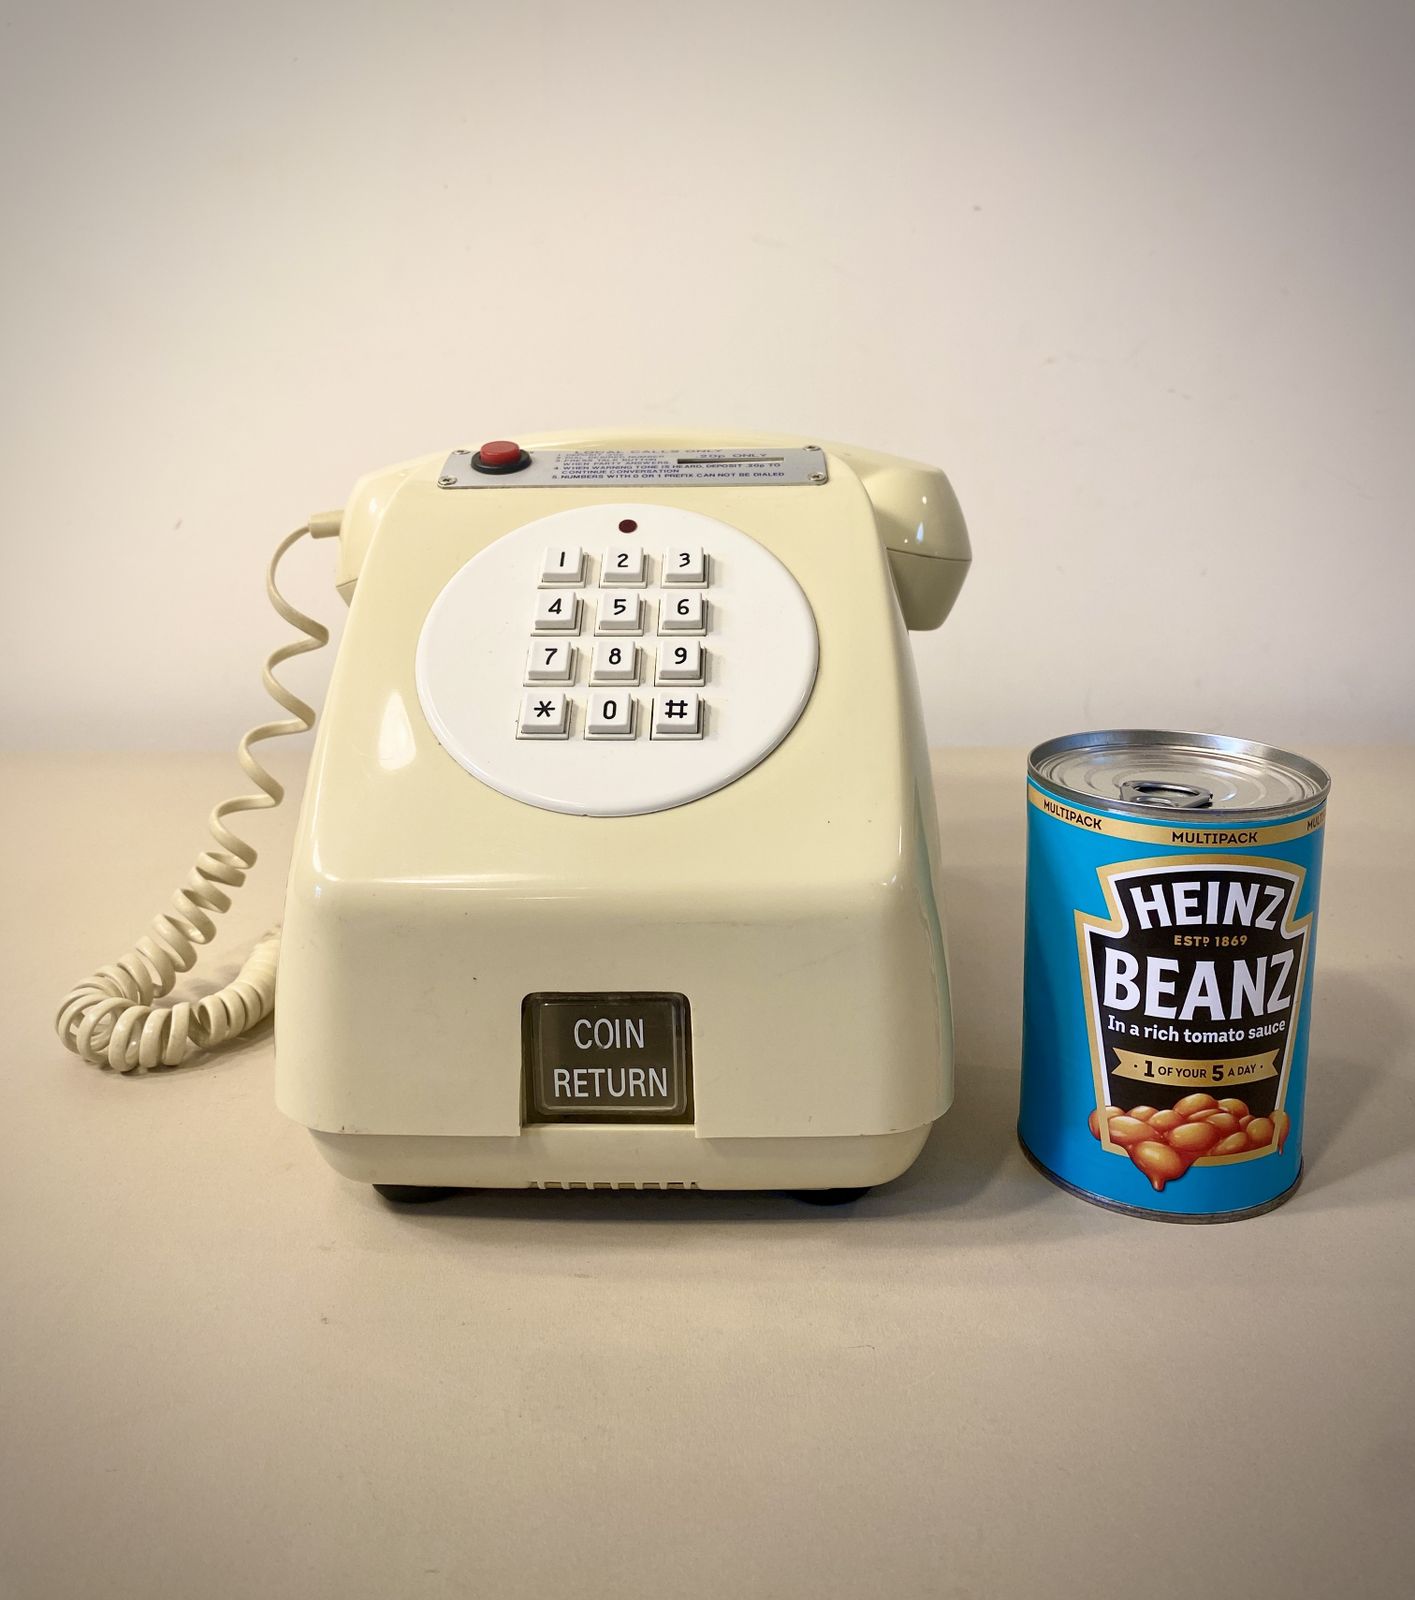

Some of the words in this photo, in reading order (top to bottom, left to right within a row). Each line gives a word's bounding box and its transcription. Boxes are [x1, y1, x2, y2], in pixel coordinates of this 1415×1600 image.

[559, 551, 566, 567] 1
[617, 553, 629, 568] 2
[679, 553, 691, 568] 3
[548, 598, 562, 614] 4
[613, 598, 627, 615] 5
[677, 598, 690, 615] 6
[544, 648, 558, 665] 7
[608, 648, 622, 665] 8
[674, 647, 688, 665] 9
[602, 700, 617, 720] 0
[1043, 799, 1102, 831] MULTIPACK
[1171, 831, 1258, 845] MULTIPACK
[1129, 881, 1285, 930] HEINZ
[1215, 934, 1248, 947] 1869
[1103, 947, 1294, 1021] BEANZ
[573, 1018, 645, 1050] COIN
[1107, 1014, 1125, 1032] In
[1129, 1023, 1140, 1036] a
[1143, 1024, 1180, 1042] rich
[1184, 1027, 1245, 1043] tomato
[1248, 1020, 1286, 1040] sauce
[1144, 1060, 1155, 1078] 1
[1157, 1066, 1173, 1077] OF
[1175, 1067, 1207, 1078] YOUR
[1211, 1065, 1224, 1081] 5
[1228, 1066, 1236, 1077] A
[1237, 1063, 1257, 1076] DAY
[553, 1067, 668, 1098] RETURN
